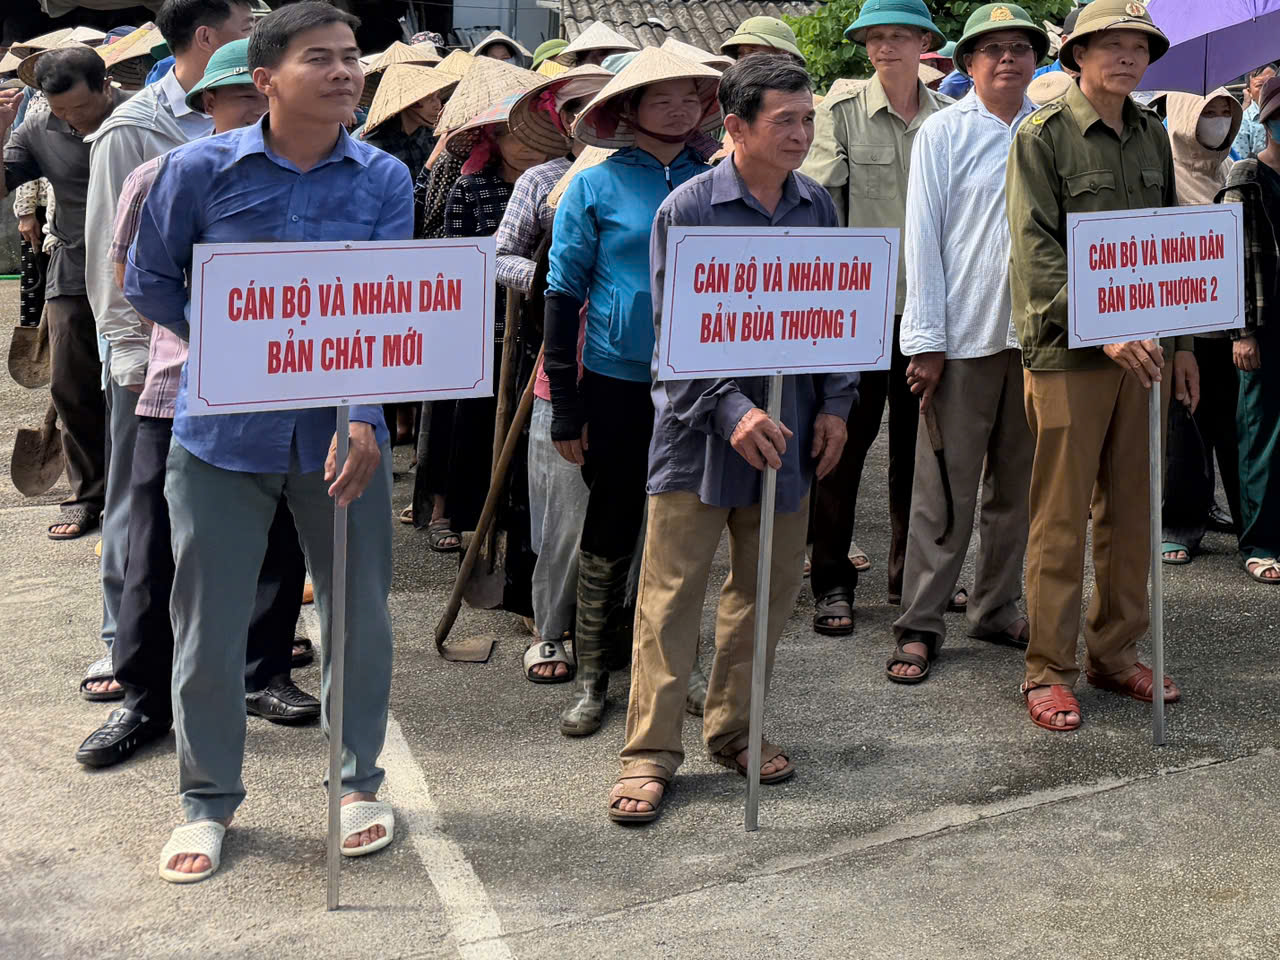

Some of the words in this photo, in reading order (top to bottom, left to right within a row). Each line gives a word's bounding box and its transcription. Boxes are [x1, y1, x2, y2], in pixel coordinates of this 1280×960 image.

[1089, 237, 1117, 271] CÁN
[1120, 235, 1138, 273] BỘ
[1141, 234, 1158, 266] VÀ
[1161, 232, 1196, 264] NHÂN
[1199, 229, 1224, 261] DÂN
[228, 280, 274, 322] CÁN
[281, 278, 311, 326] BỘ
[318, 276, 346, 317] VÀ
[352, 274, 412, 315] NHÂN
[419, 272, 462, 312] DÂN
[693, 256, 730, 294] CÁN
[734, 256, 757, 299] BỘ
[763, 256, 783, 292] VÀ
[788, 256, 835, 291] NHÂN
[838, 256, 872, 290] DÂN
[1098, 277, 1126, 314] BẢN
[1129, 277, 1155, 311] BÙA
[1158, 276, 1208, 310] THƯỢNG
[1210, 276, 1218, 302] 2
[700, 302, 737, 343] BẢN
[741, 305, 775, 342] BÙA
[780, 307, 844, 346] THƯỢNG
[850, 309, 857, 338] 1
[267, 328, 314, 374] BẢN
[320, 329, 376, 372] CHÁT
[382, 327, 423, 367] MỚI
